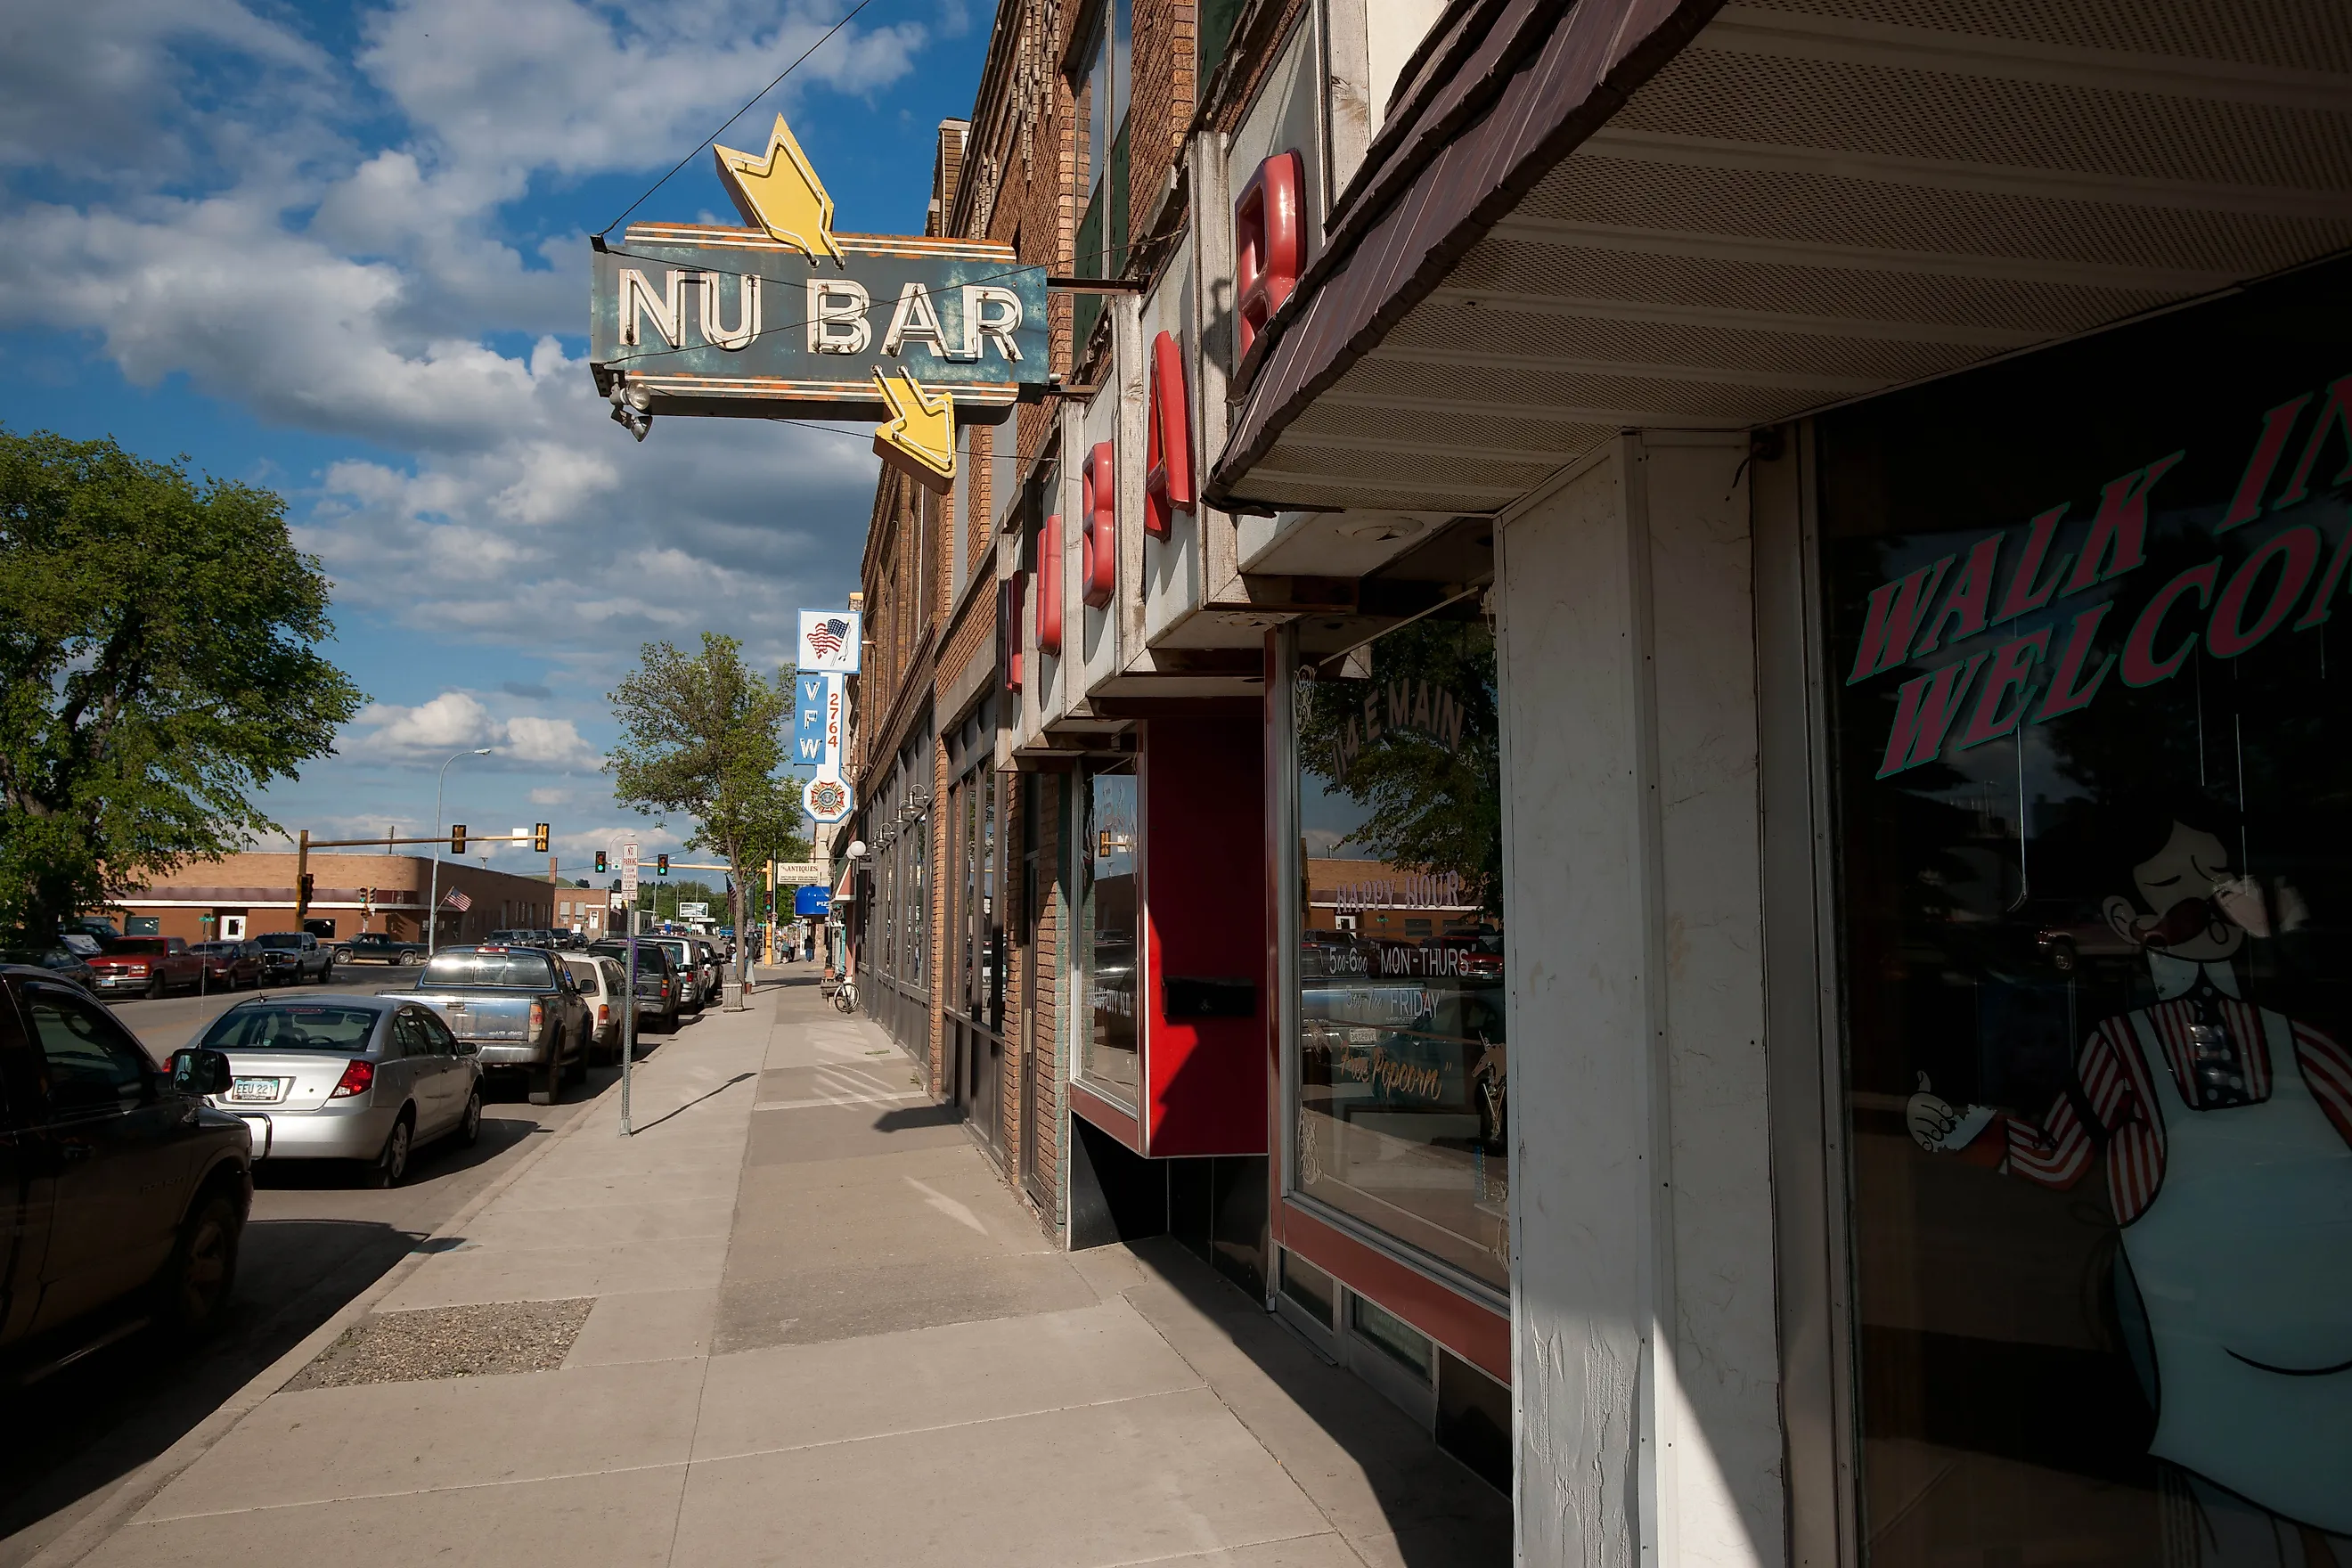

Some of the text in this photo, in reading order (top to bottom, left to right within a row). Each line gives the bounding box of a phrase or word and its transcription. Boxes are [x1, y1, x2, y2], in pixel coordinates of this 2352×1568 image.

[619, 268, 1024, 363] NU BAR
[1846, 449, 2185, 685] WALK
[827, 693, 839, 747] 2764
[1363, 689, 1384, 743] E
[1387, 675, 1466, 755] MAIN
[623, 857, 637, 866] PARKING
[627, 846, 634, 855] NO
[786, 865, 819, 873] ANTIQUES
[1335, 869, 1461, 915] HAPPY HOUR
[236, 1083, 255, 1094] EEU
